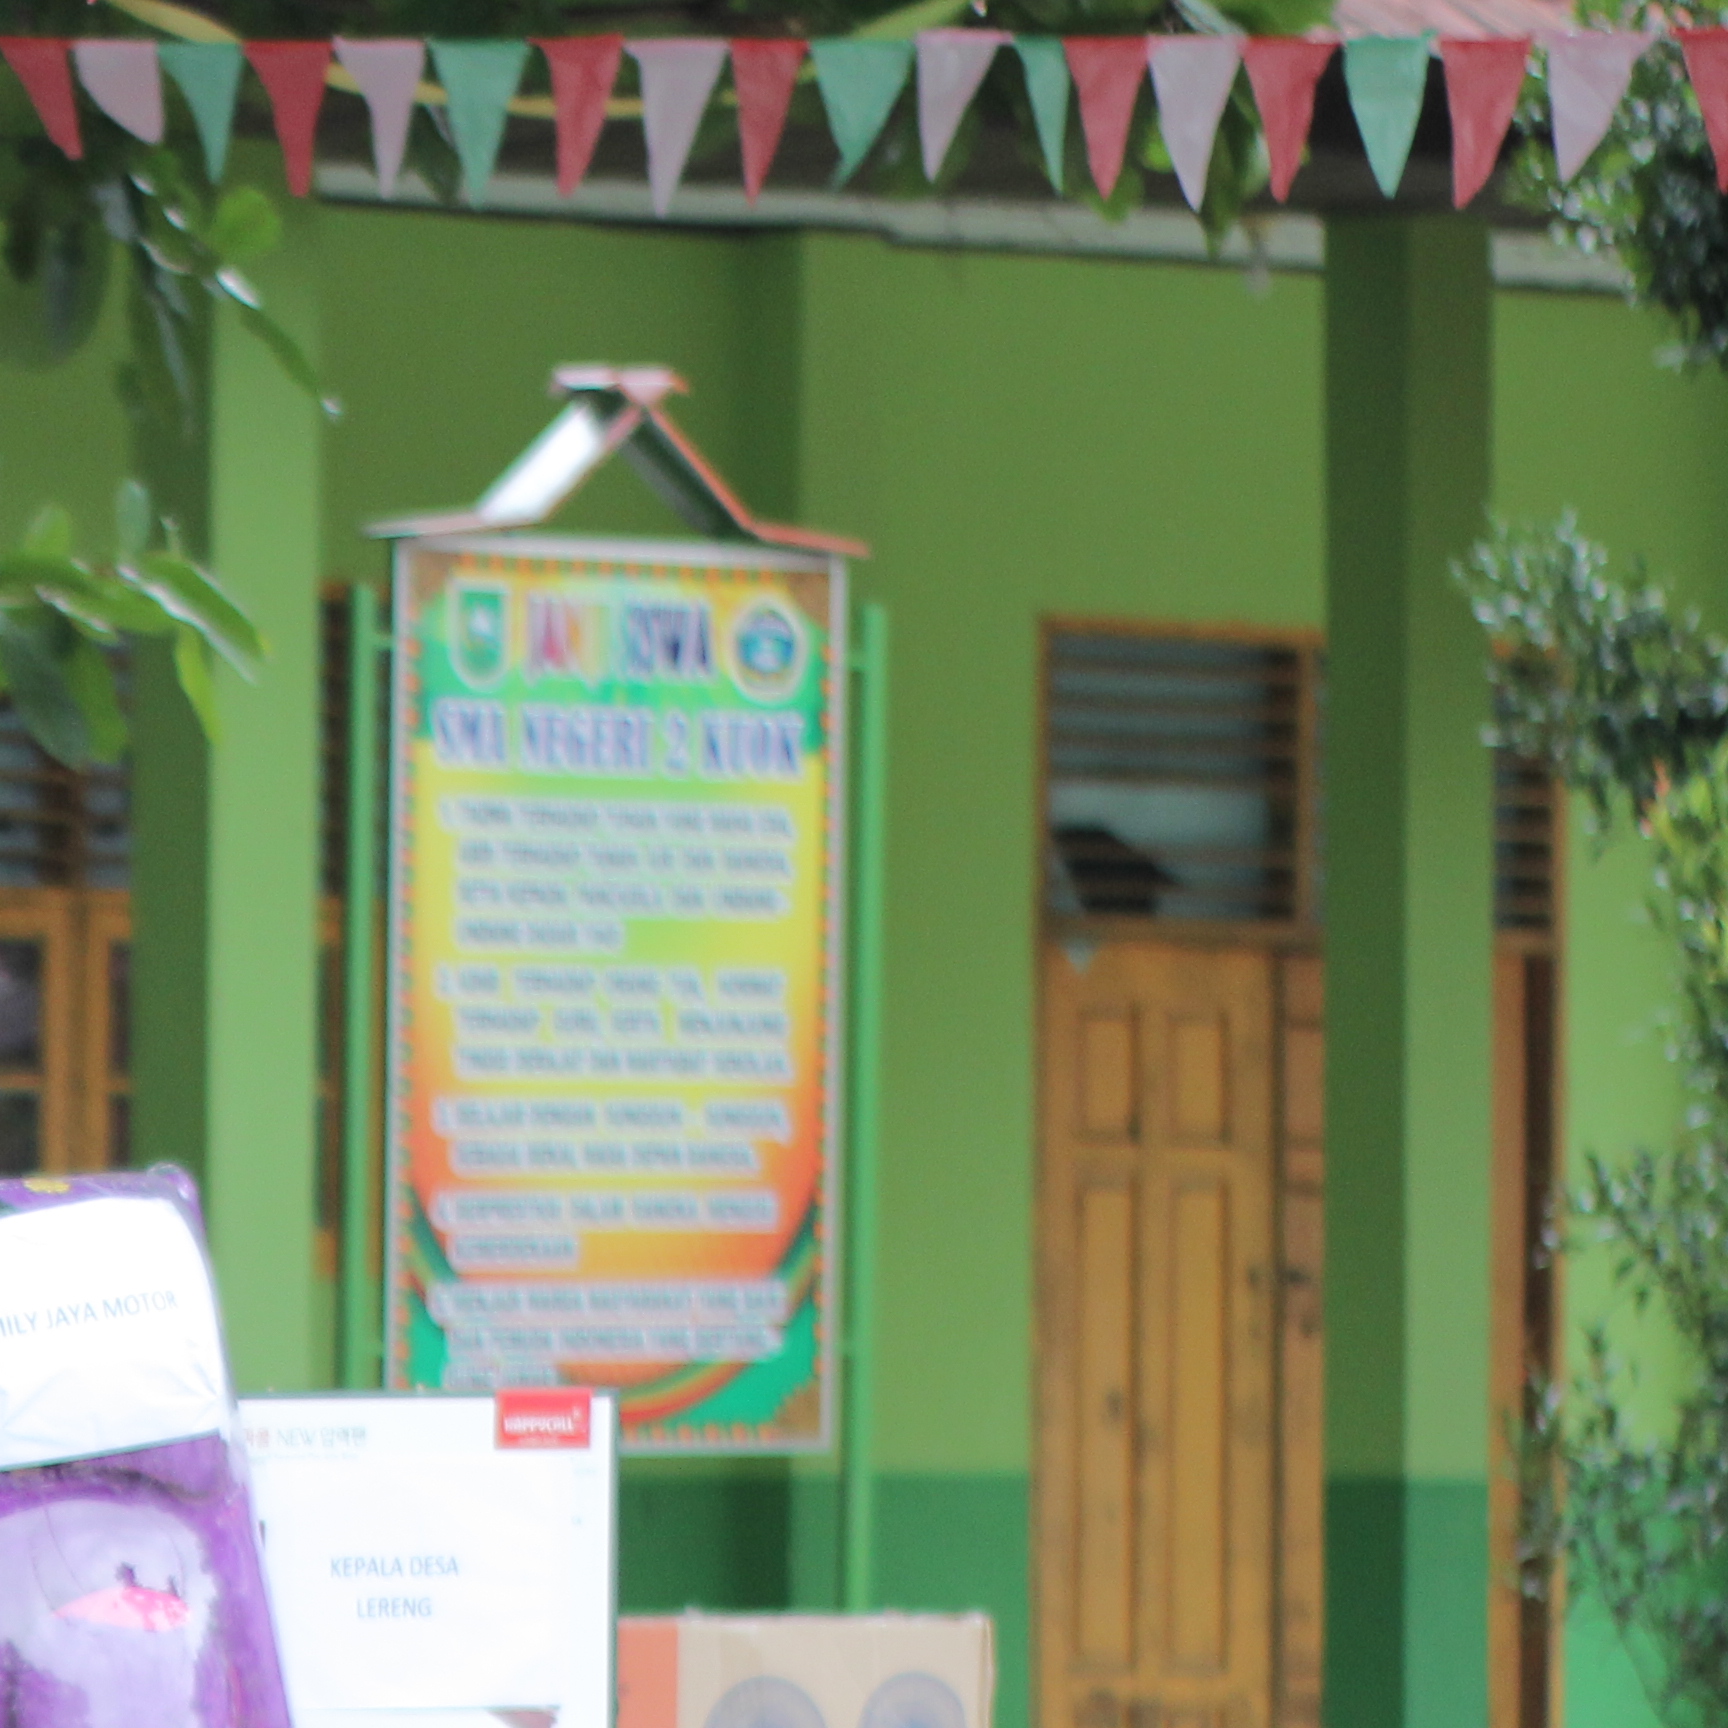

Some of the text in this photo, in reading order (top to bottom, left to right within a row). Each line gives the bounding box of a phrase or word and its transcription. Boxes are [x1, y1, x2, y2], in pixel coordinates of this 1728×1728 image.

[521, 708, 649, 772] NEGERI
[661, 711, 688, 776] 2
[701, 715, 800, 779] KUOK
[46, 1301, 99, 1330] JAYA
[102, 1289, 179, 1320] MOTOR
[277, 1429, 316, 1447] NEW
[330, 1556, 460, 1579] KEPALA DESA
[356, 1598, 433, 1619] LERENG
